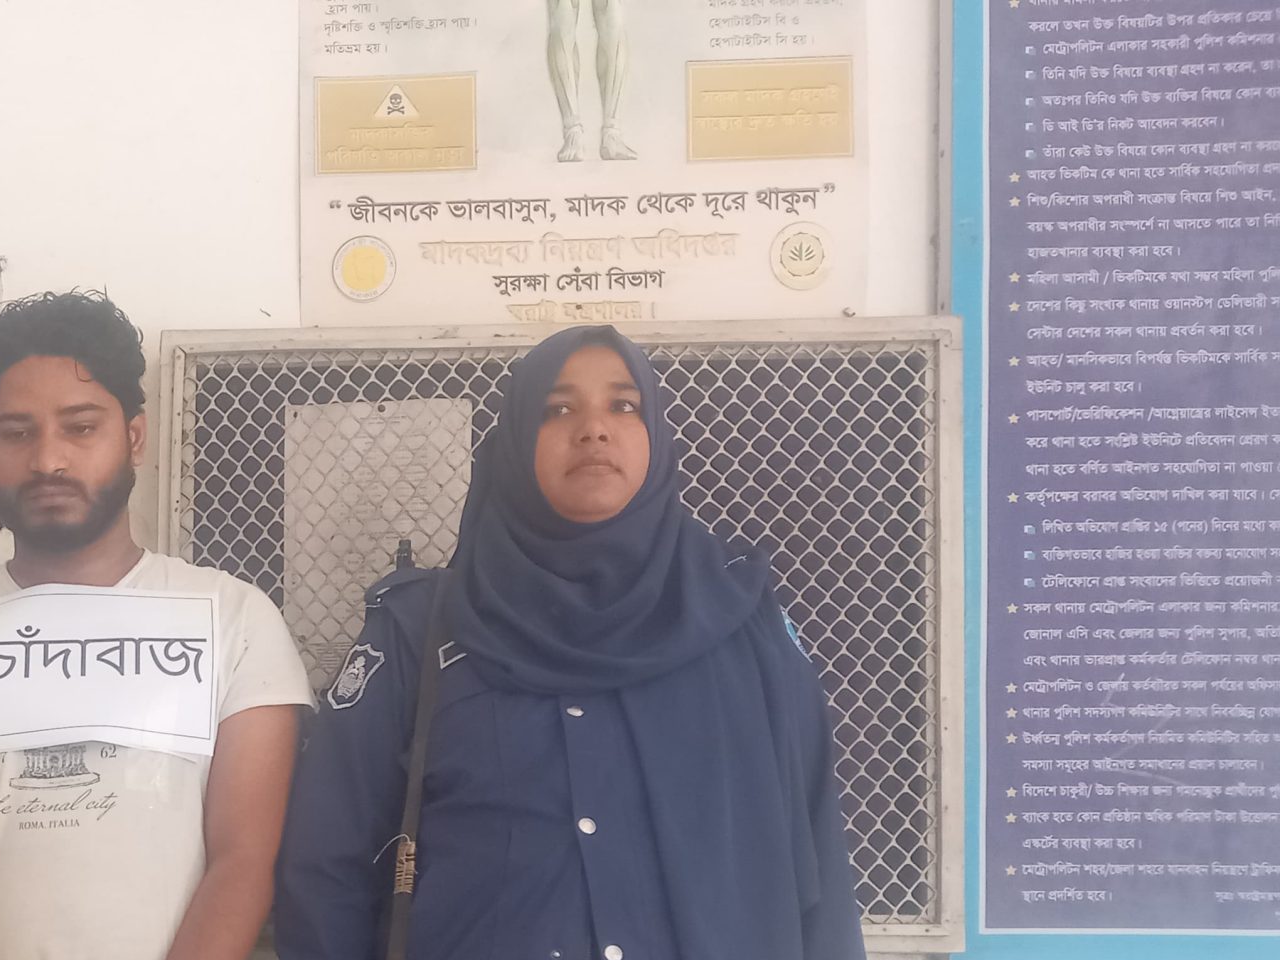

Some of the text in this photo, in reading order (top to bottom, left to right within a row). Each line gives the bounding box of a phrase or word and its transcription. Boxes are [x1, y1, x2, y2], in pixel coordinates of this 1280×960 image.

[368, 23, 376, 31] ও
[348, 187, 820, 224] জীবনকে ভালবাসুন, মাদক থেকে দূরে থাকুন
[493, 272, 550, 296] সুরক্ষা
[606, 267, 666, 290] বিভাগ
[100, 745, 117, 759] 62
[16, 788, 92, 815] eternal
[85, 792, 120, 821] city
[49, 818, 81, 829] ITALIA
